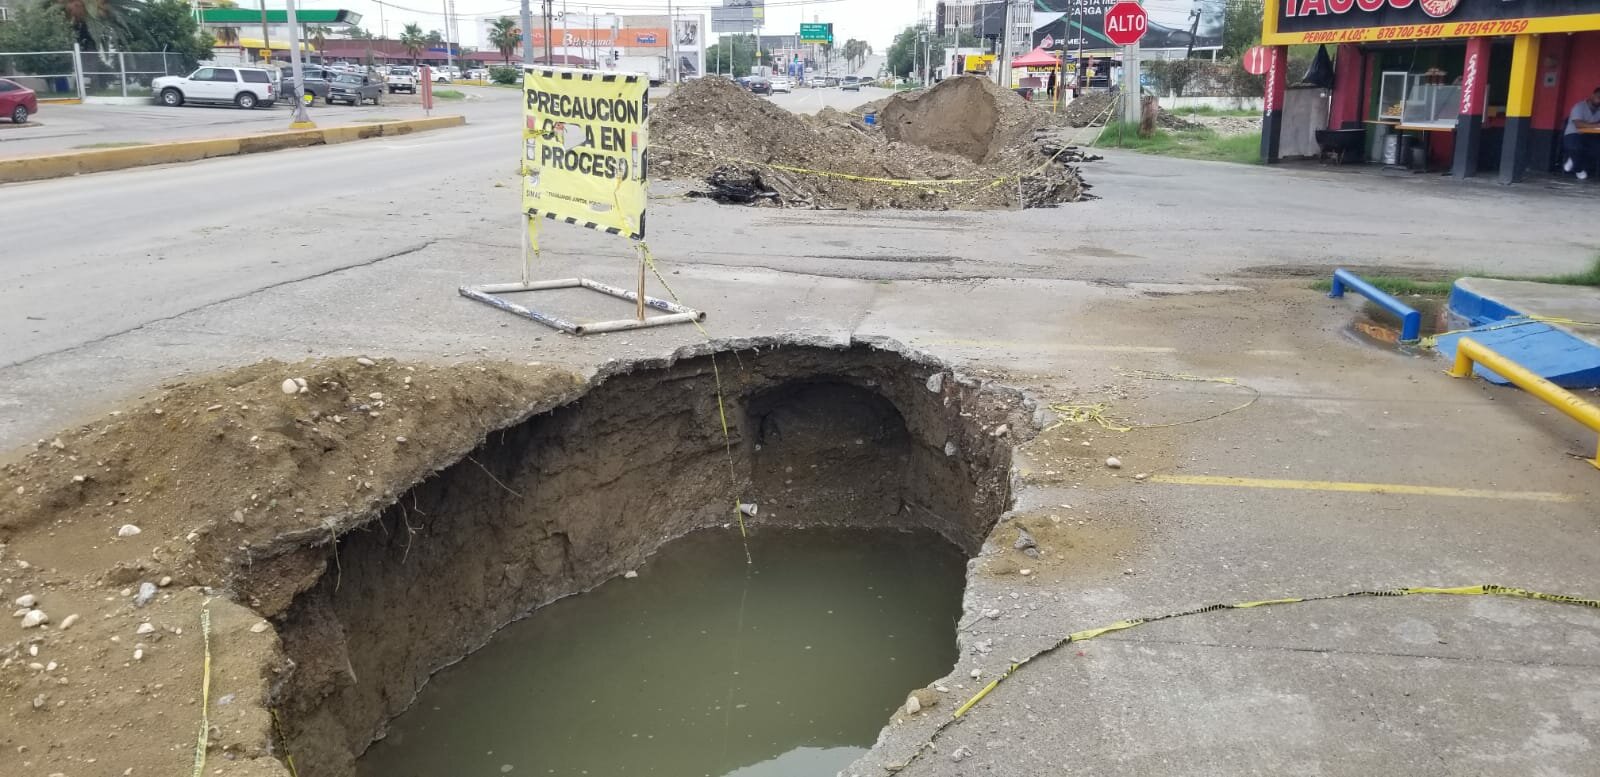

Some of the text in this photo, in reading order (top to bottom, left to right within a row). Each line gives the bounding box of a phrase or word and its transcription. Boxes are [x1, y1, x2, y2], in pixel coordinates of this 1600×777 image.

[1108, 15, 1145, 33] ALTO
[1303, 31, 1337, 43] PEDIDOS
[1415, 25, 1445, 37] 5491
[526, 88, 639, 124] PRECAUCIÓN
[541, 118, 626, 152] OA EN
